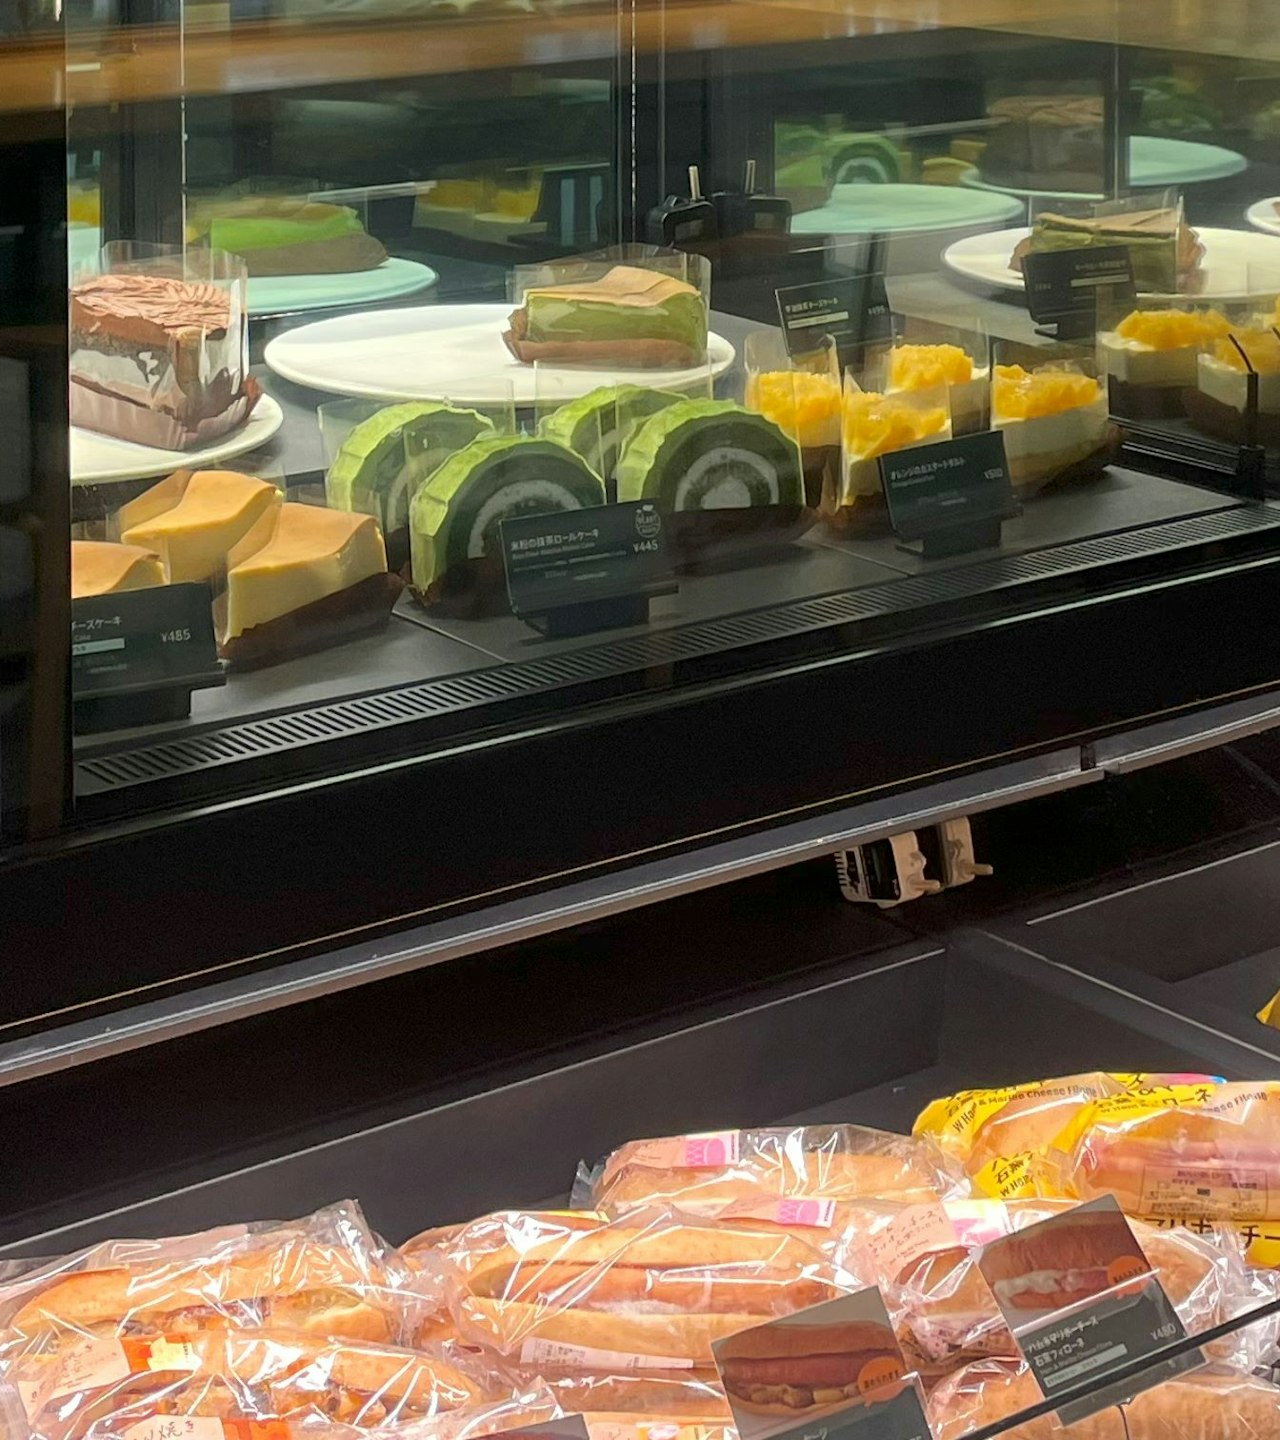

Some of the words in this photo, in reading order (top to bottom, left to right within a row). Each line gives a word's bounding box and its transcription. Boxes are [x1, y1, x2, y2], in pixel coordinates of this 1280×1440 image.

[633, 541, 658, 553] ¥445
[160, 628, 191, 643] ¥485
[1026, 1087, 1065, 1100] Cheese
